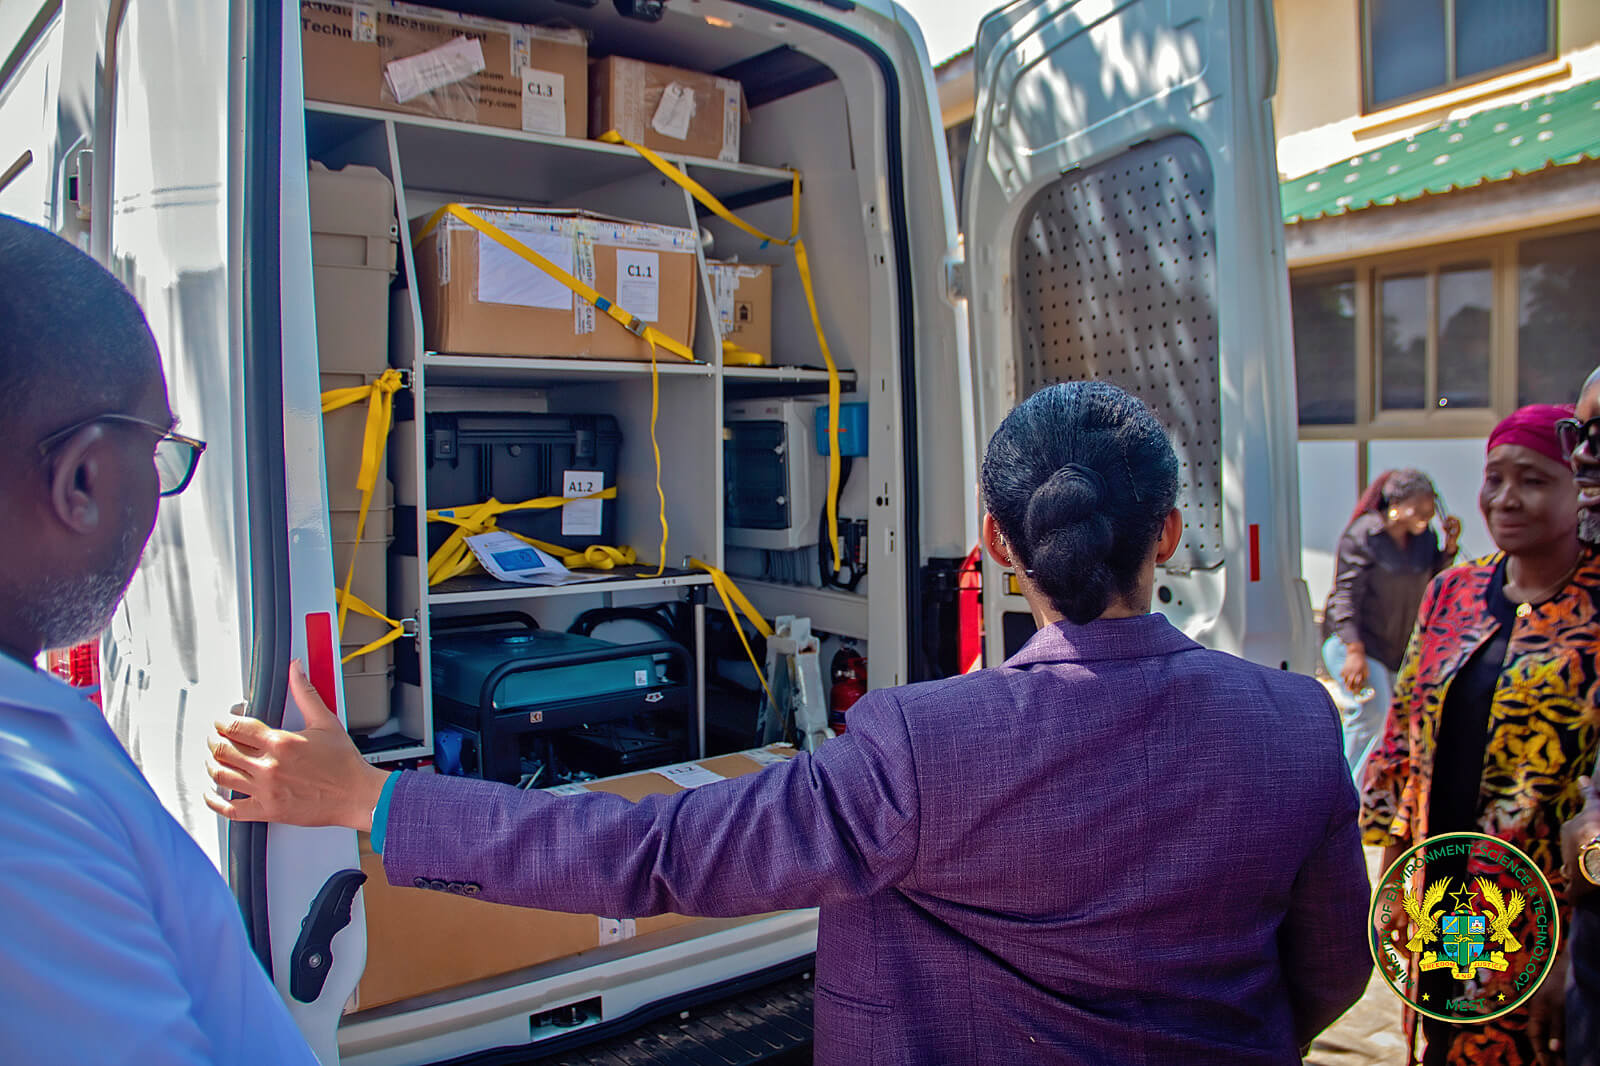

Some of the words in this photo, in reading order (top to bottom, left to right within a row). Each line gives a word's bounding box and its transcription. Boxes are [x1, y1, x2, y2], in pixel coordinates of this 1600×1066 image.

[302, 17, 394, 48] Techngy
[528, 82, 553, 97] C1.3
[627, 264, 652, 278] C1.1
[568, 481, 593, 492] A1.2
